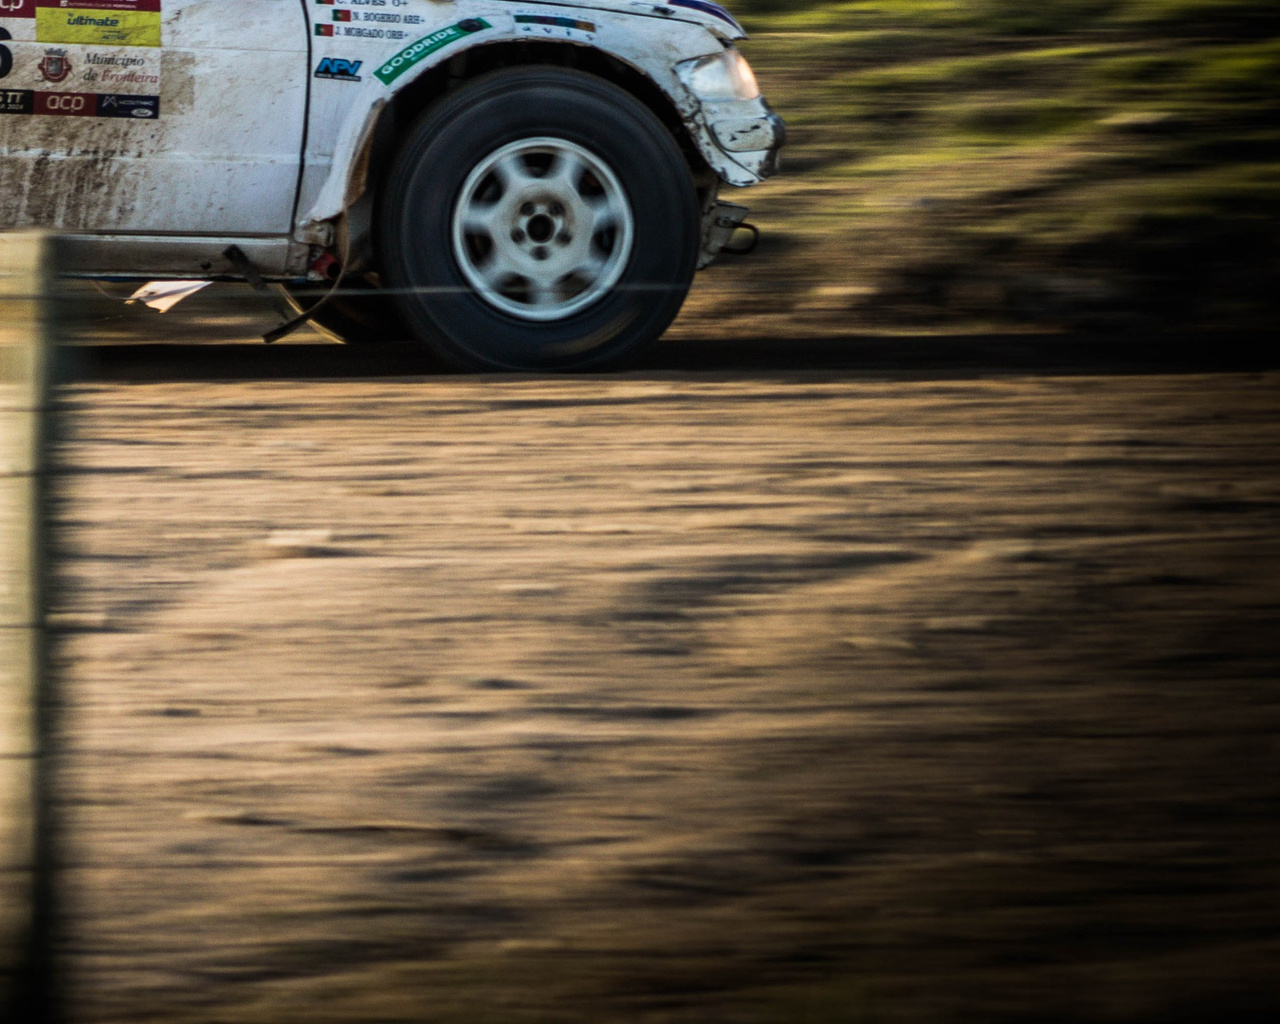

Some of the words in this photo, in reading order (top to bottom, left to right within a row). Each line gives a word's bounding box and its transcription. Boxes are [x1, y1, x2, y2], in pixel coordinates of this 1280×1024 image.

[67, 15, 120, 27] ultimate
[344, 27, 384, 38] MORGADO
[380, 27, 457, 74] GOODRIDE
[83, 68, 99, 81] de
[101, 69, 159, 84] Fronteira
[6, 92, 24, 103] TT
[46, 95, 85, 113] acp
